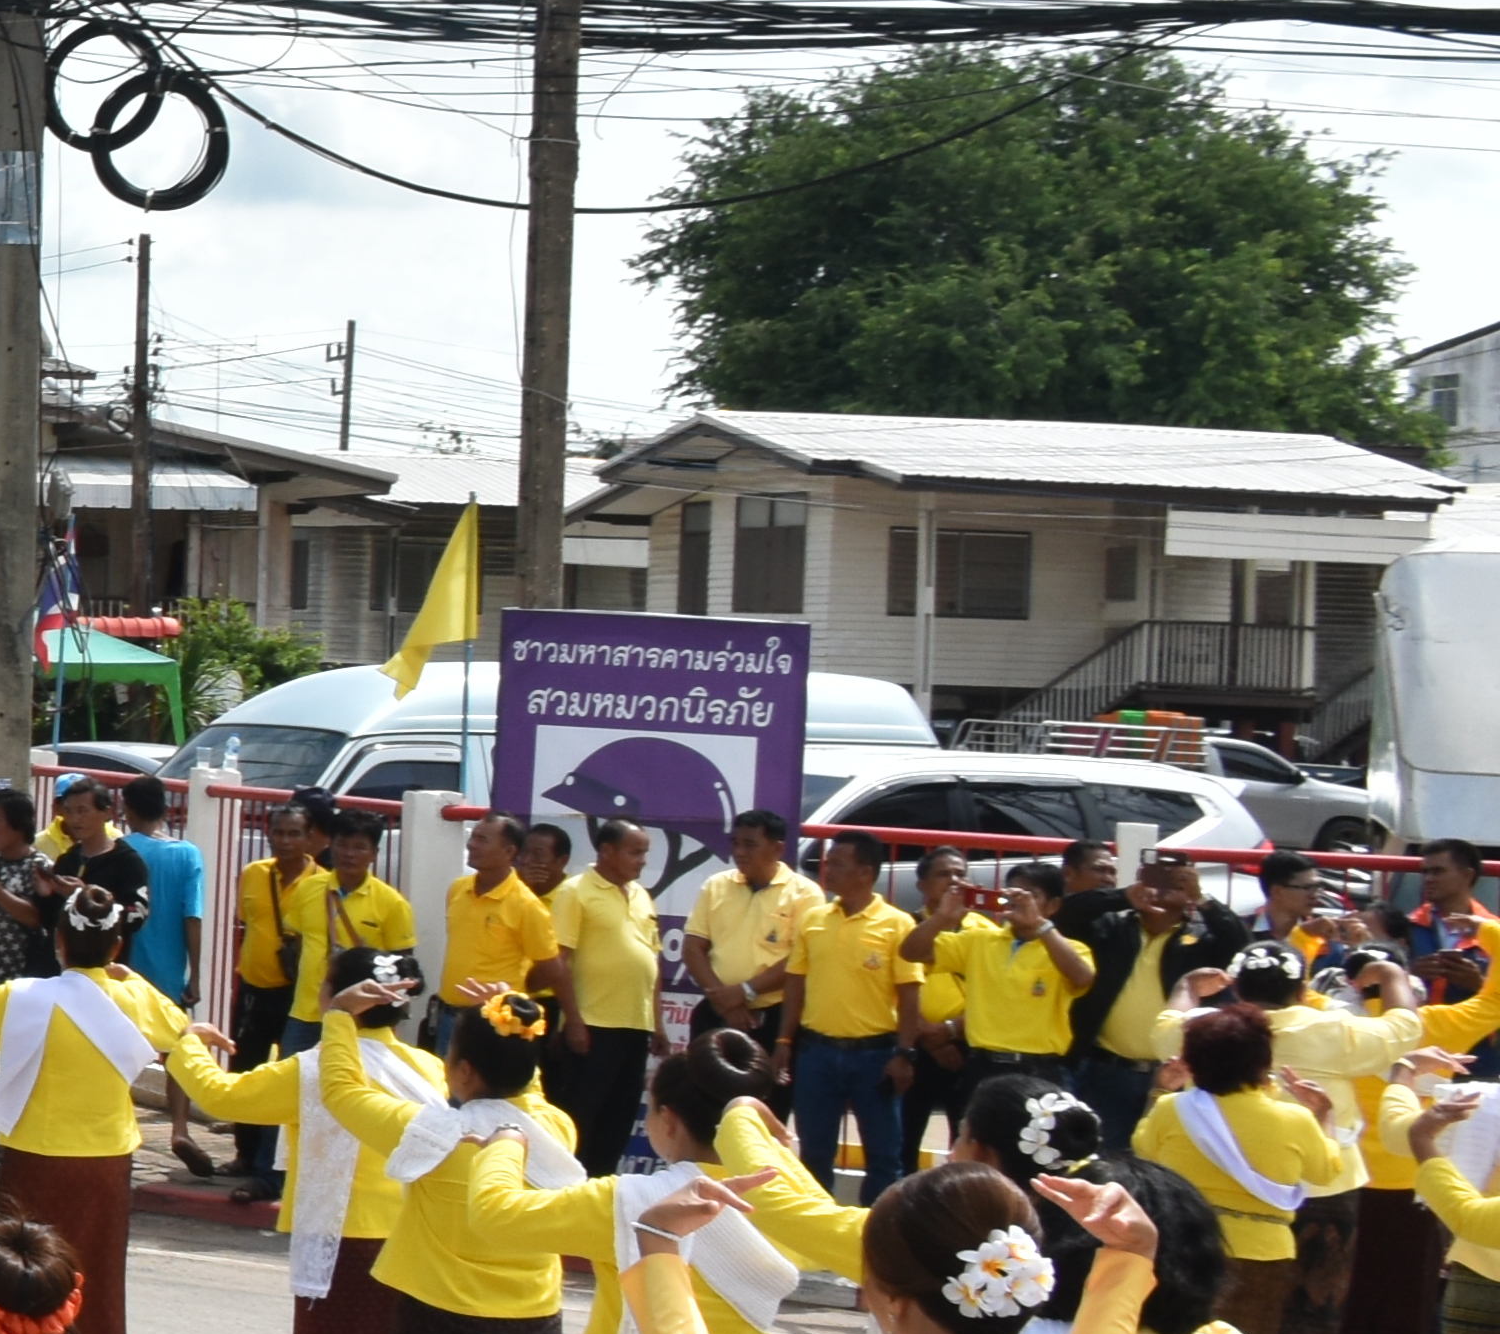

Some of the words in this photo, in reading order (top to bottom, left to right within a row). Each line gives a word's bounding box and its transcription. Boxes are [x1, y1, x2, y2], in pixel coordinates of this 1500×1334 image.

[512, 636, 792, 674] ชาวมหาสารคามร่วมใจ
[527, 686, 774, 727] สวมหมวกนิรภัย
